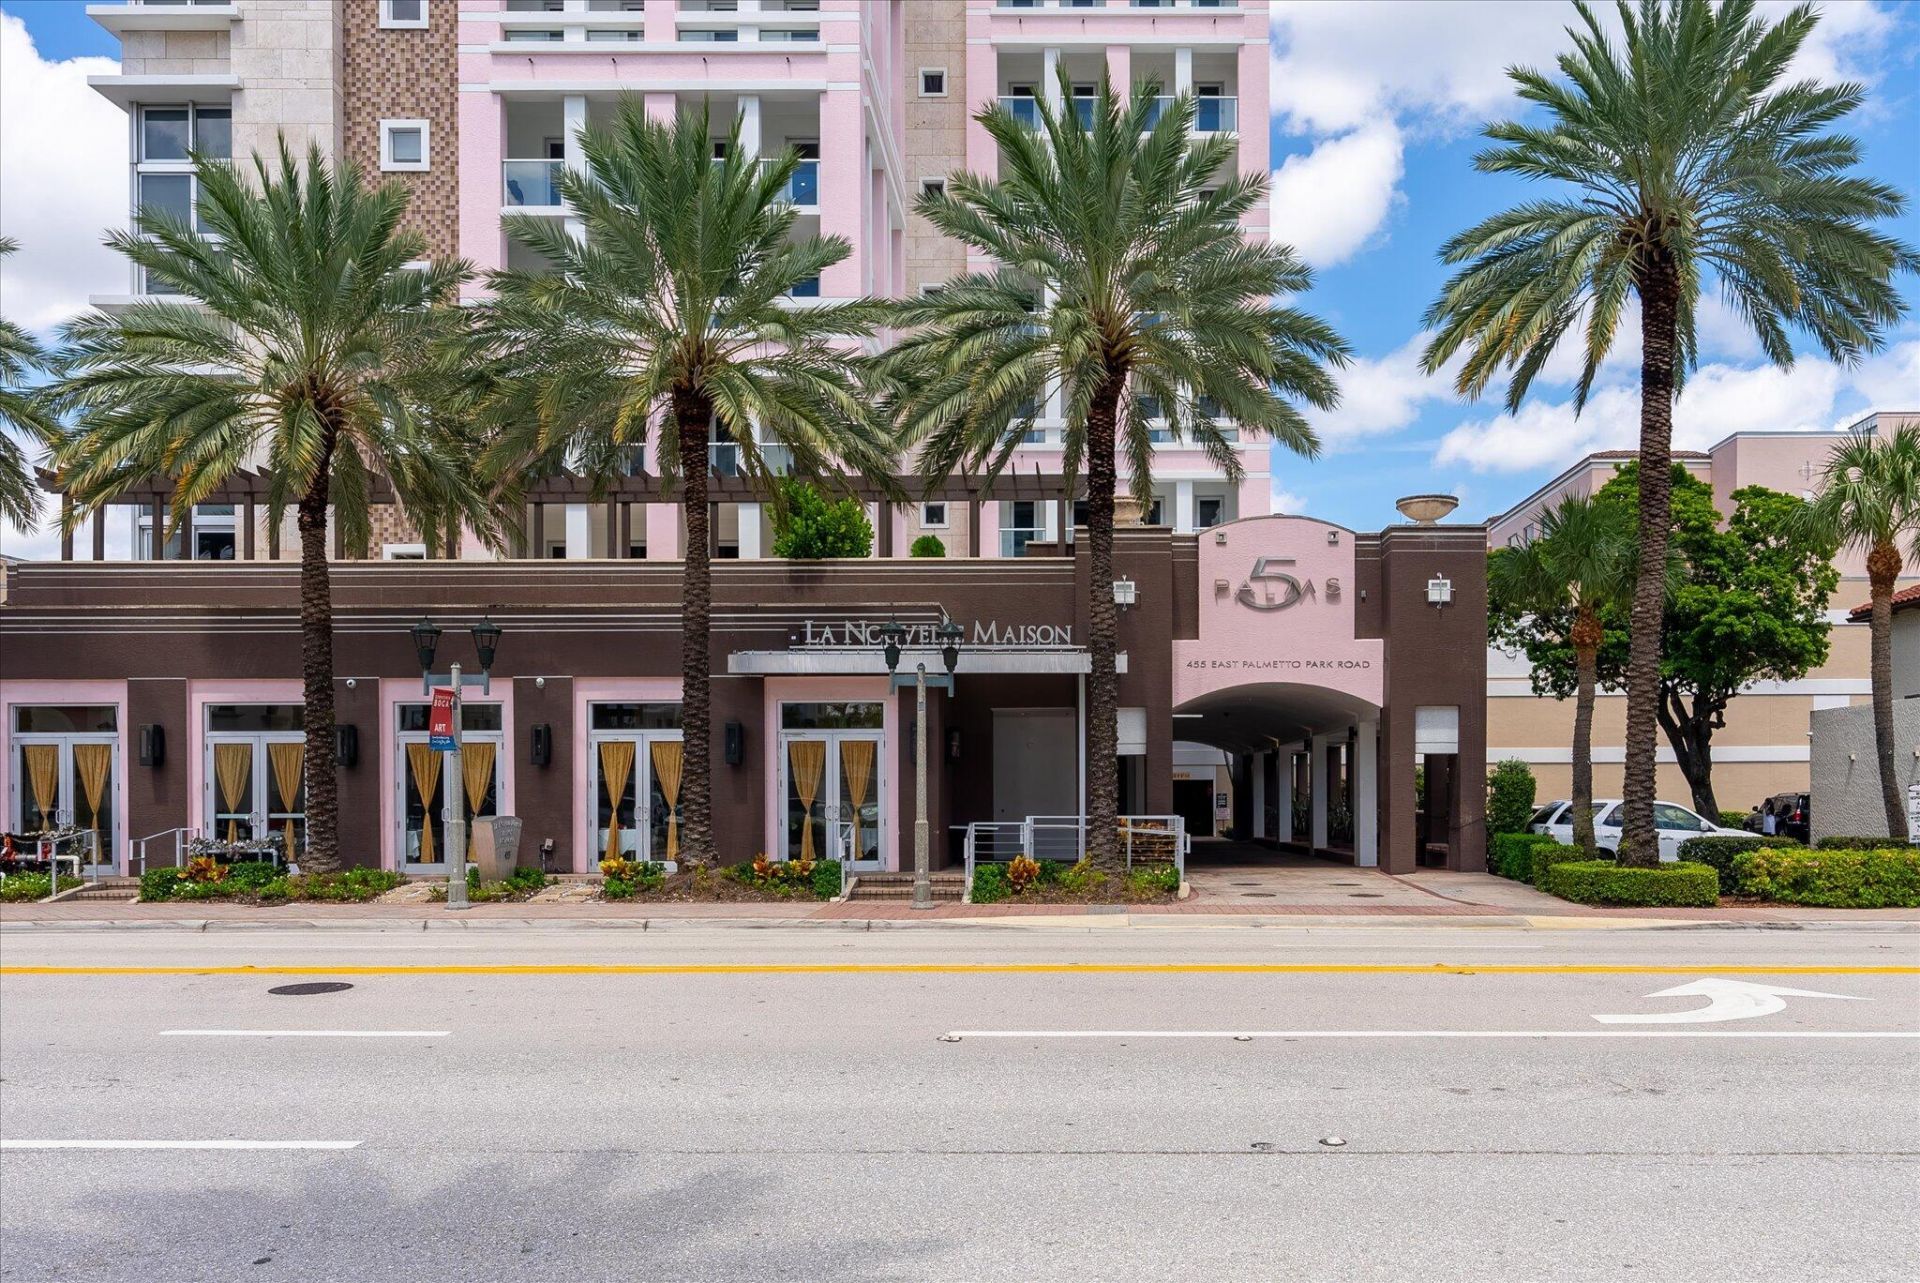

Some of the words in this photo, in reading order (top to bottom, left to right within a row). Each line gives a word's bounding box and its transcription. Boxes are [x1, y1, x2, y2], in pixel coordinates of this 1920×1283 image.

[1238, 555, 1302, 610] 5
[804, 620, 837, 644] LA
[972, 619, 1073, 644] MAISON
[1186, 660, 1207, 669] 455
[1211, 660, 1239, 669] EAST
[1242, 660, 1301, 669] PALMETTO
[1305, 660, 1334, 669] PARK
[1337, 660, 1371, 669] ROAD
[433, 699, 450, 707] BOCA
[434, 723, 446, 732] ART
